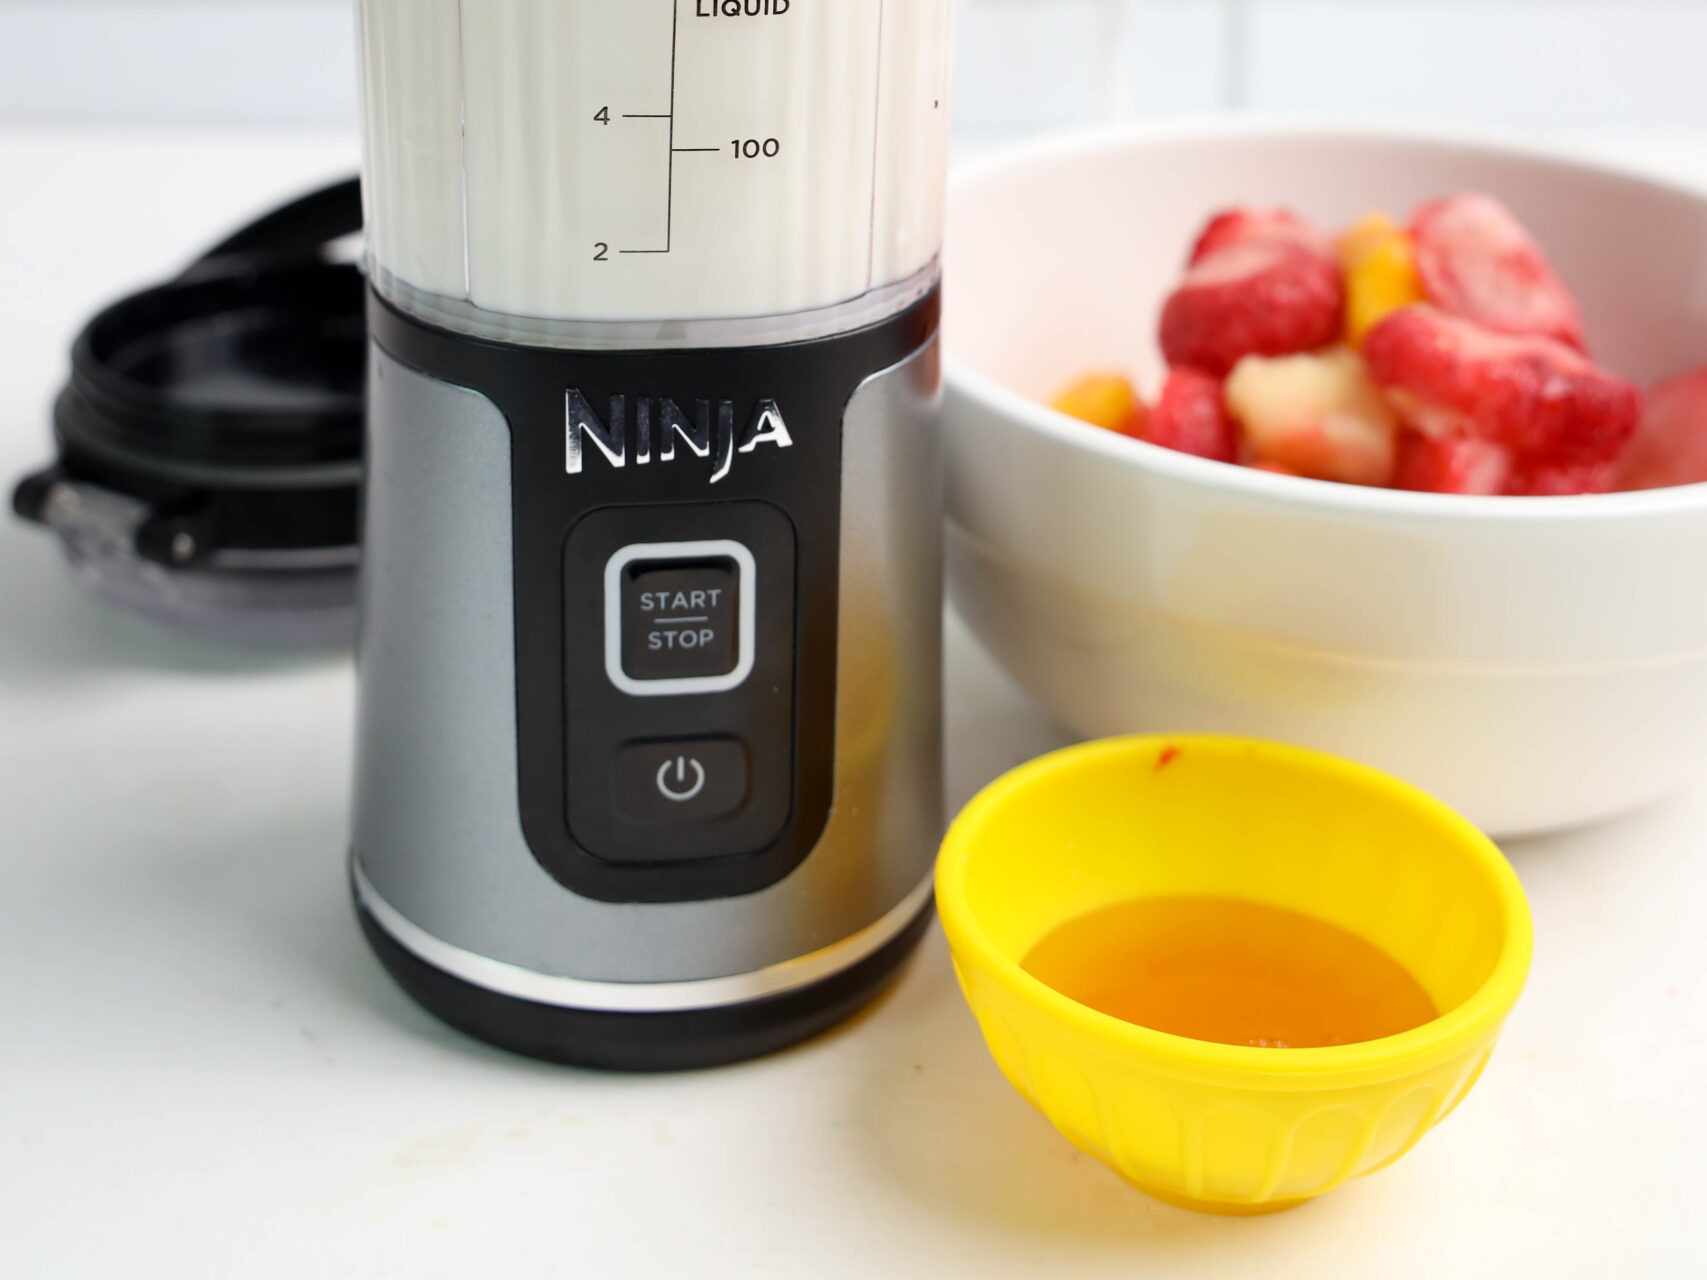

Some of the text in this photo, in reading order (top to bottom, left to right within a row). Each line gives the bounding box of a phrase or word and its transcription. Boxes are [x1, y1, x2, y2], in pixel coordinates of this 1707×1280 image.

[593, 106, 611, 126] 4
[731, 137, 780, 159] 100
[592, 241, 609, 262] 2
[564, 387, 794, 484] NINJA
[639, 587, 723, 612] START
[647, 627, 715, 651] STOP
